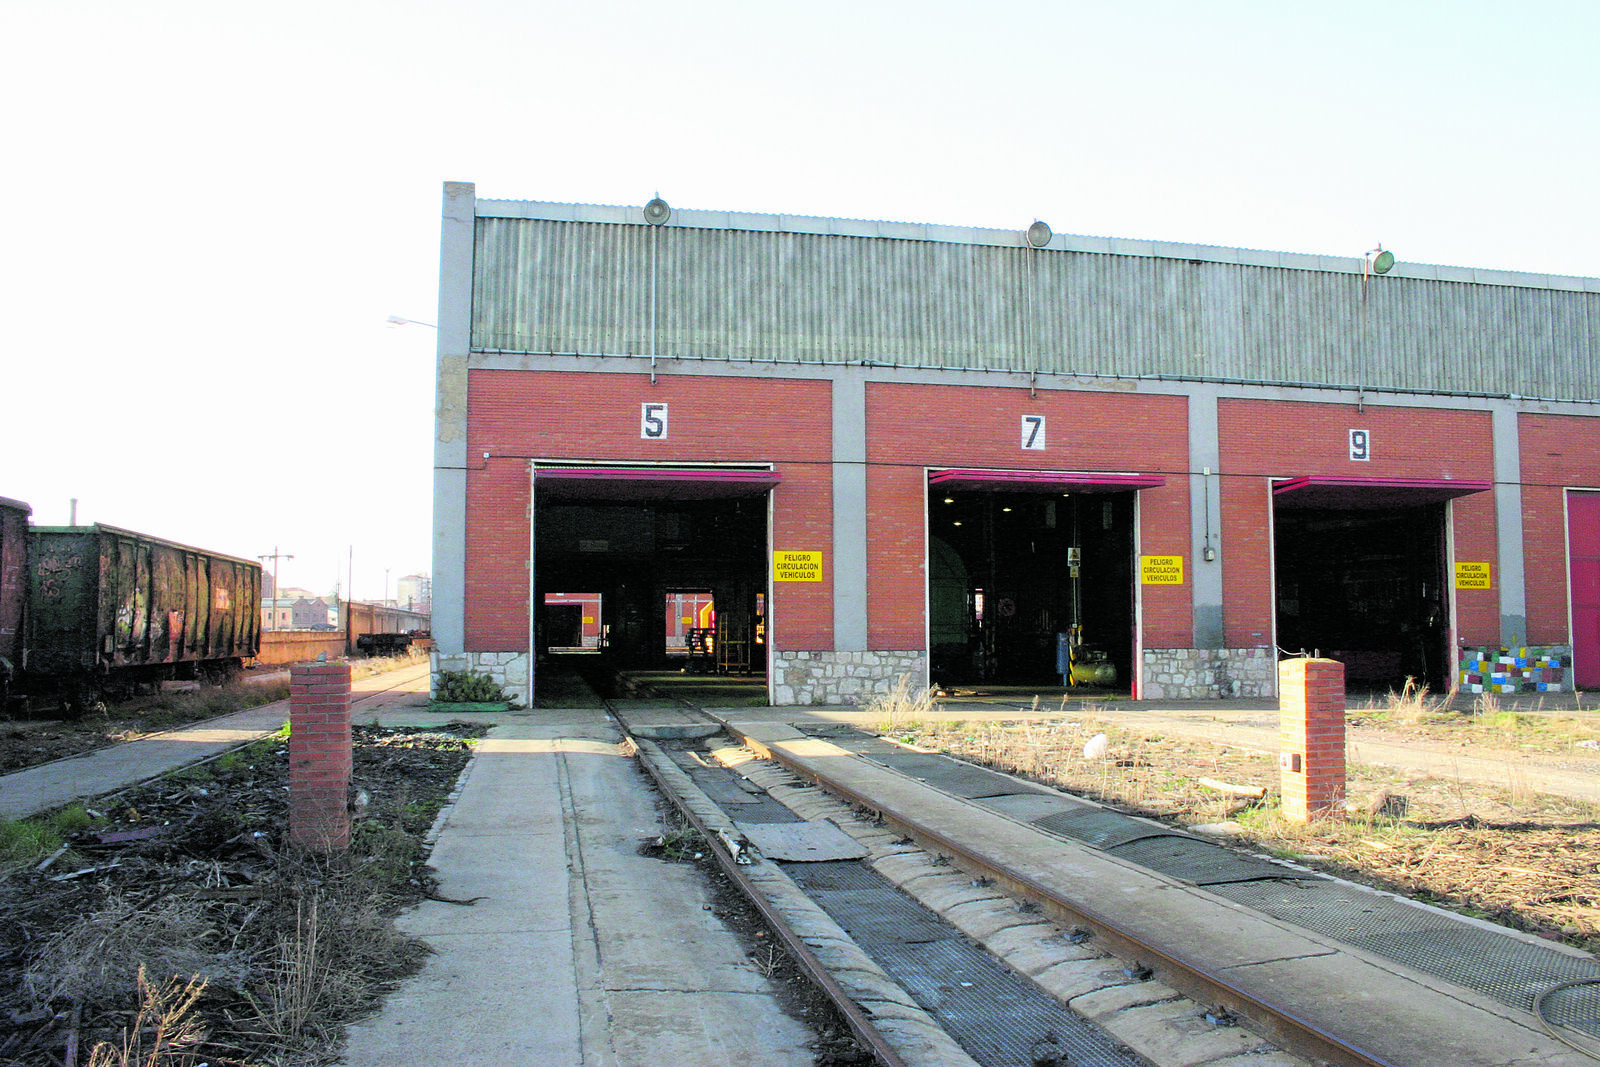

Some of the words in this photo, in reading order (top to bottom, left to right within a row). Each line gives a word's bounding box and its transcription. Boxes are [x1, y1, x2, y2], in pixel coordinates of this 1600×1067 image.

[645, 404, 663, 437] 5
[1025, 416, 1041, 448] 7
[1352, 431, 1366, 459] 9
[776, 562, 819, 570] CIRCULACION
[1150, 558, 1174, 566] PELIGRO
[1143, 566, 1180, 574] CIRCULACION
[1461, 564, 1482, 572] PELIGRO
[780, 571, 816, 579] VEHICULOS
[1146, 574, 1178, 582] VEHICULOS
